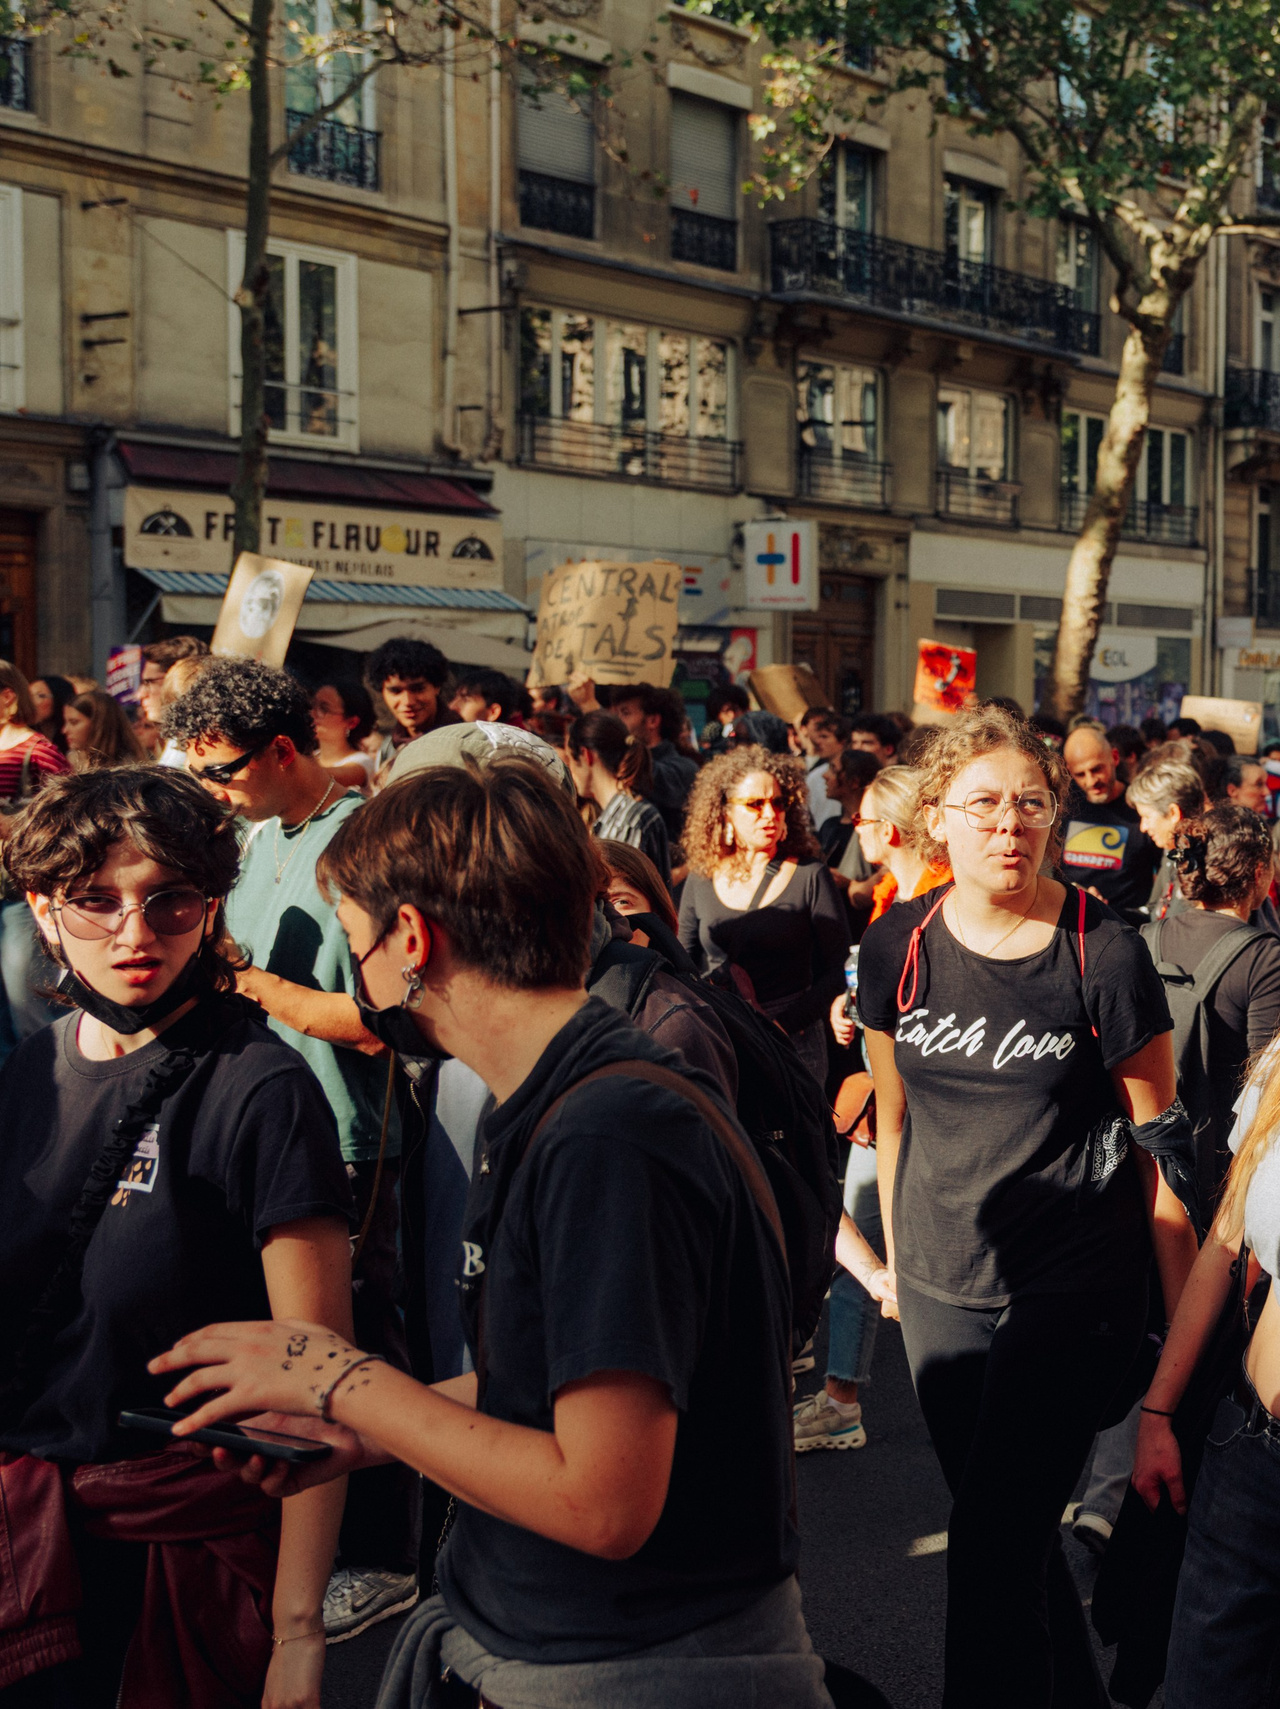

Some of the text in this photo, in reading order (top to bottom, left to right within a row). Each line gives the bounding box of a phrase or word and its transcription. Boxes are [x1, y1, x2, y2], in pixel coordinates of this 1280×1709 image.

[313, 521, 440, 557] FLAVOUR
[895, 1008, 1076, 1070] Catch love
